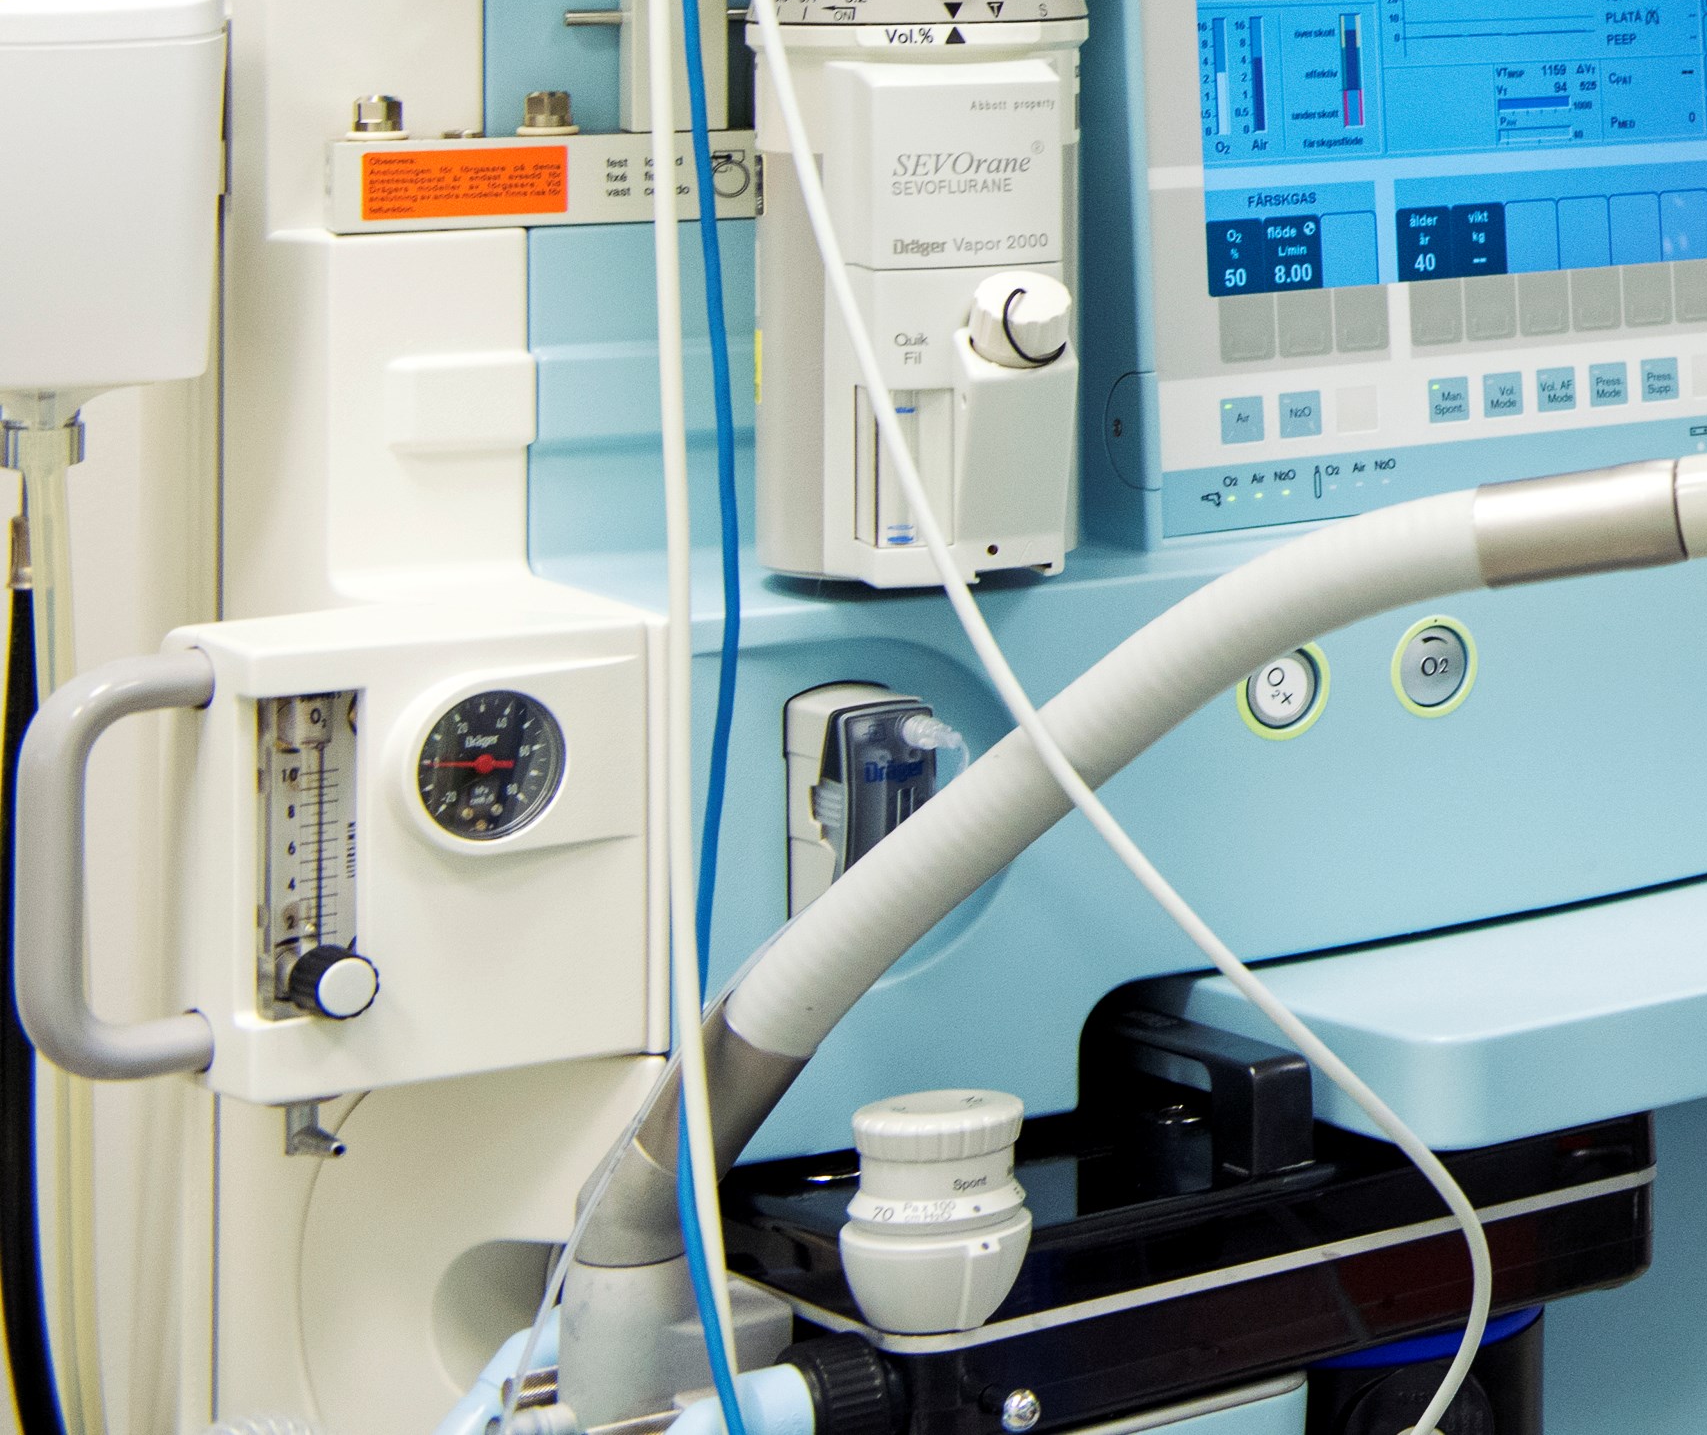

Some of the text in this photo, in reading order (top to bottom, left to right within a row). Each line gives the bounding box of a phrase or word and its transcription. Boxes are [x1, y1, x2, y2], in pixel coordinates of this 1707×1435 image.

[885, 27, 934, 45] Vol.%
[1606, 34, 1637, 46] PEEP
[970, 99, 1055, 111] Abbott property
[1215, 142, 1230, 155] O2
[1251, 139, 1268, 151] Air
[892, 178, 1013, 195] SEVOFLURANE
[1409, 214, 1437, 227] ålder
[1468, 212, 1488, 223] vikt
[1227, 230, 1242, 243] O2
[1267, 226, 1297, 240] flöde
[1472, 232, 1485, 243] kg
[892, 233, 1049, 257] Dräger Vapor 2000
[1278, 246, 1307, 258] L/min
[1414, 253, 1436, 272] 40
[1224, 269, 1247, 287] 50
[1274, 263, 1312, 284] 8.00
[894, 333, 928, 348] Quik
[904, 351, 922, 365] Fil
[1560, 380, 1573, 390] AF
[1548, 393, 1573, 403] Mode
[1596, 388, 1621, 399] Mode
[1490, 399, 1517, 409] Mode
[1236, 412, 1250, 423] Air
[1325, 458, 1396, 476] O2 Air N2O
[1223, 469, 1296, 487] O2 Air N2O
[864, 759, 924, 783] Dräger
[288, 841, 296, 855] 6
[288, 877, 296, 891] 4
[953, 1176, 988, 1192] Spont
[872, 1206, 895, 1222] 70
